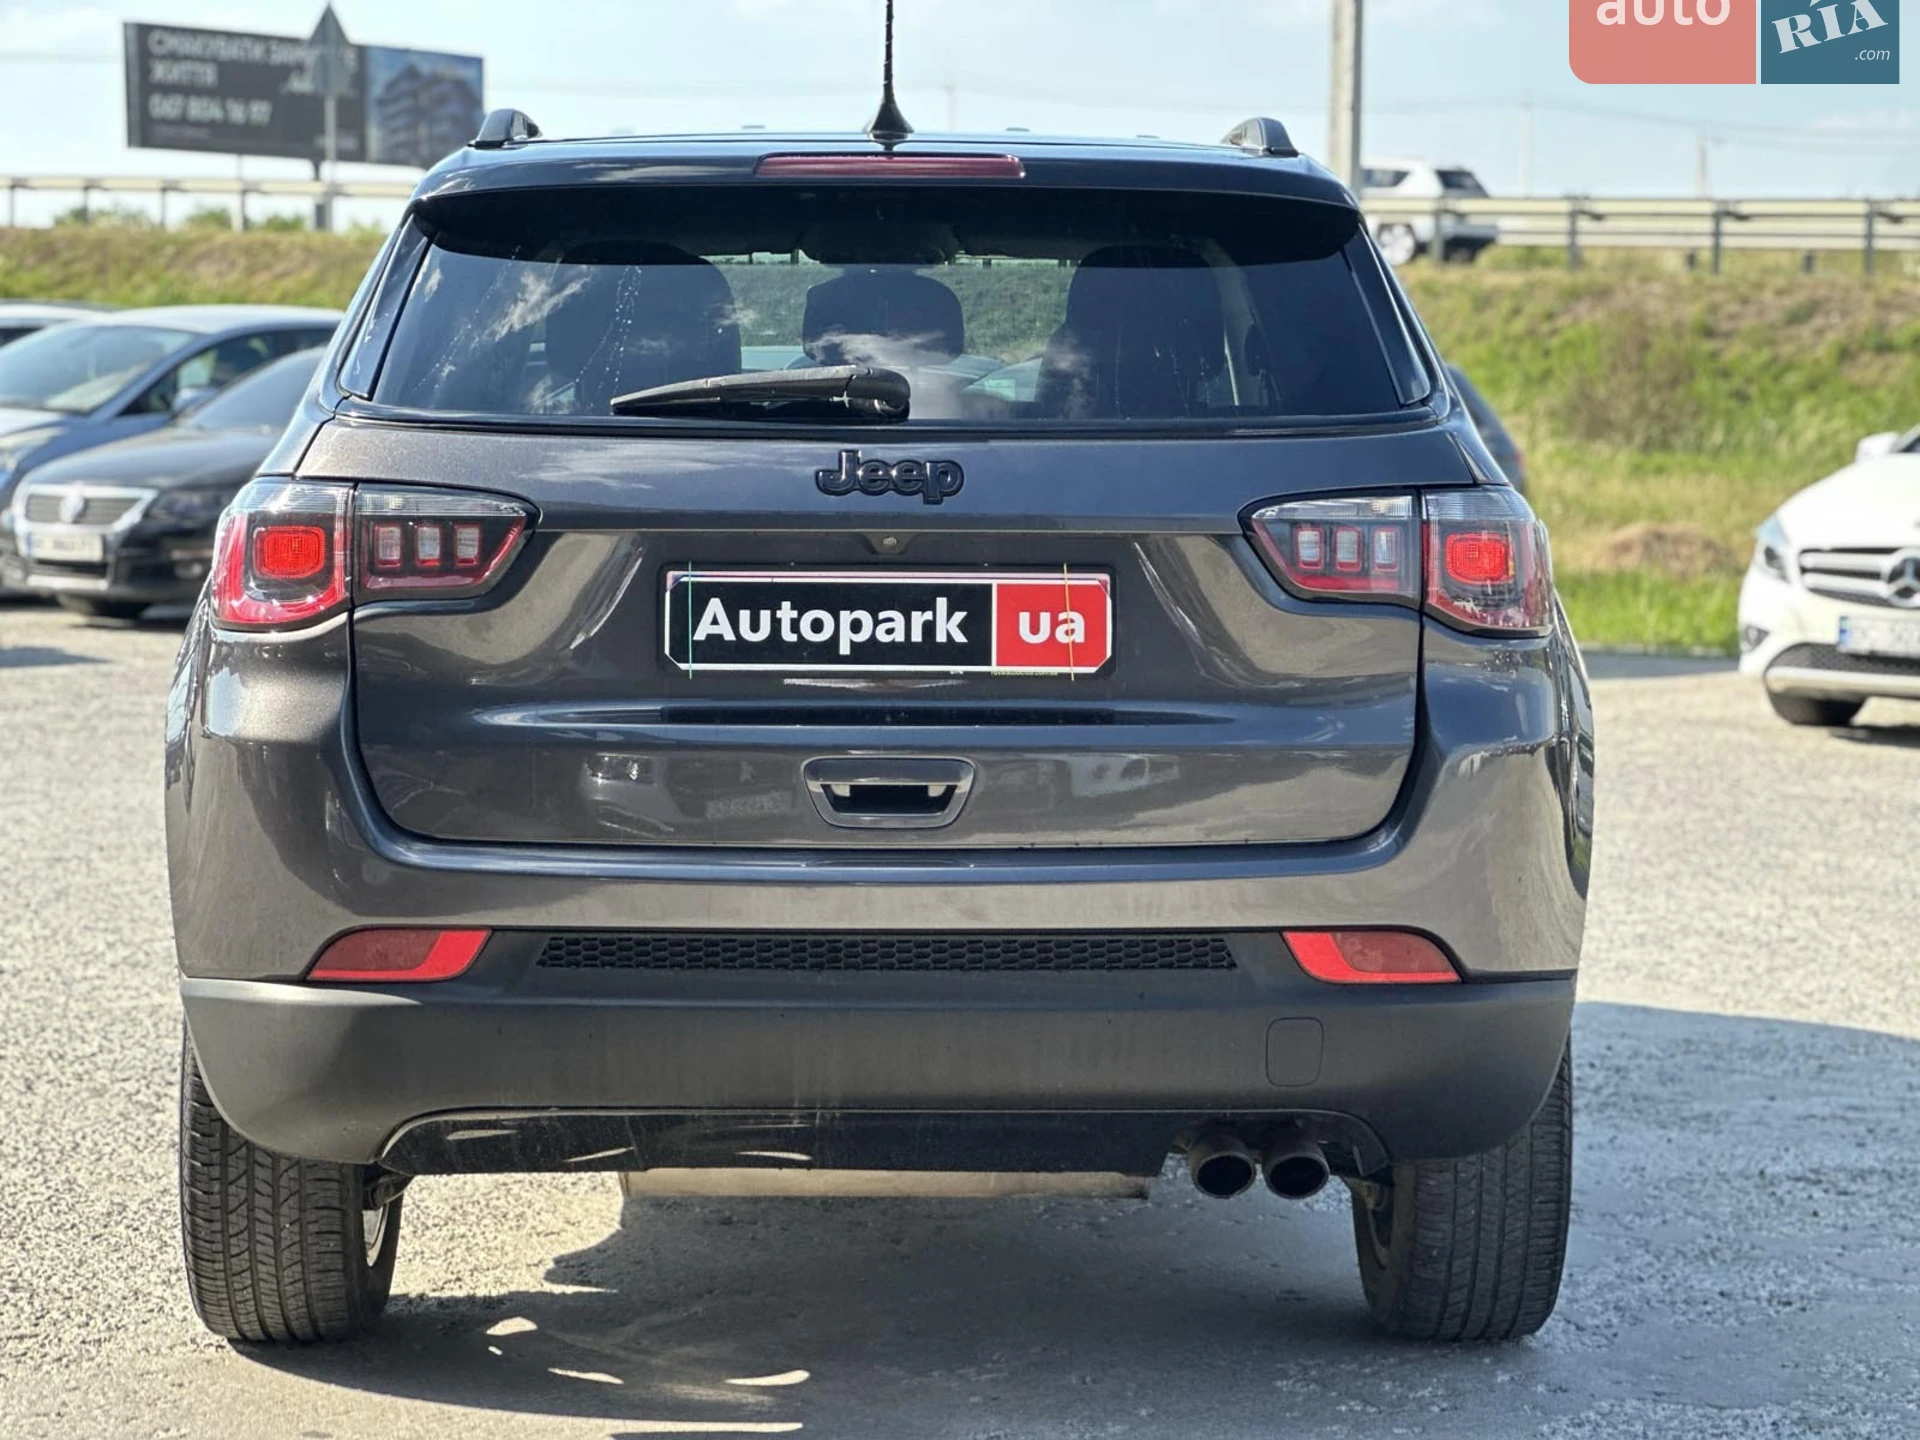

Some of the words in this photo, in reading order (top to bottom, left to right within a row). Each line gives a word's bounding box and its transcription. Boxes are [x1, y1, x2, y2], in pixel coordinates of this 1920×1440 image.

[815, 449, 964, 505] Jeep
[692, 596, 968, 656] Autopark
[1018, 610, 1085, 644] ua
